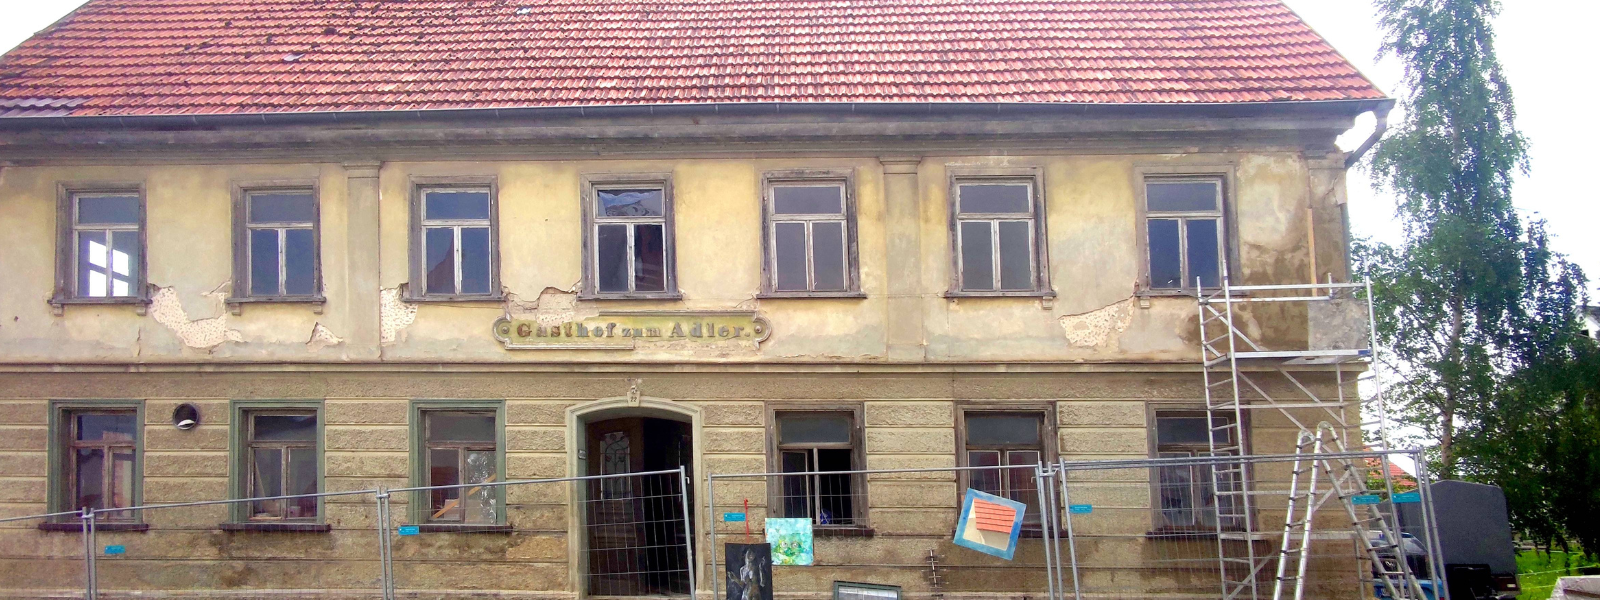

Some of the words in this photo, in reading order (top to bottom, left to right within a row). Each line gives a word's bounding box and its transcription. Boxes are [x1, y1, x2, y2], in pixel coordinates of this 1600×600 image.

[517, 322, 617, 338] Gasthof
[621, 327, 661, 338] zum
[668, 321, 750, 338] Adler.
